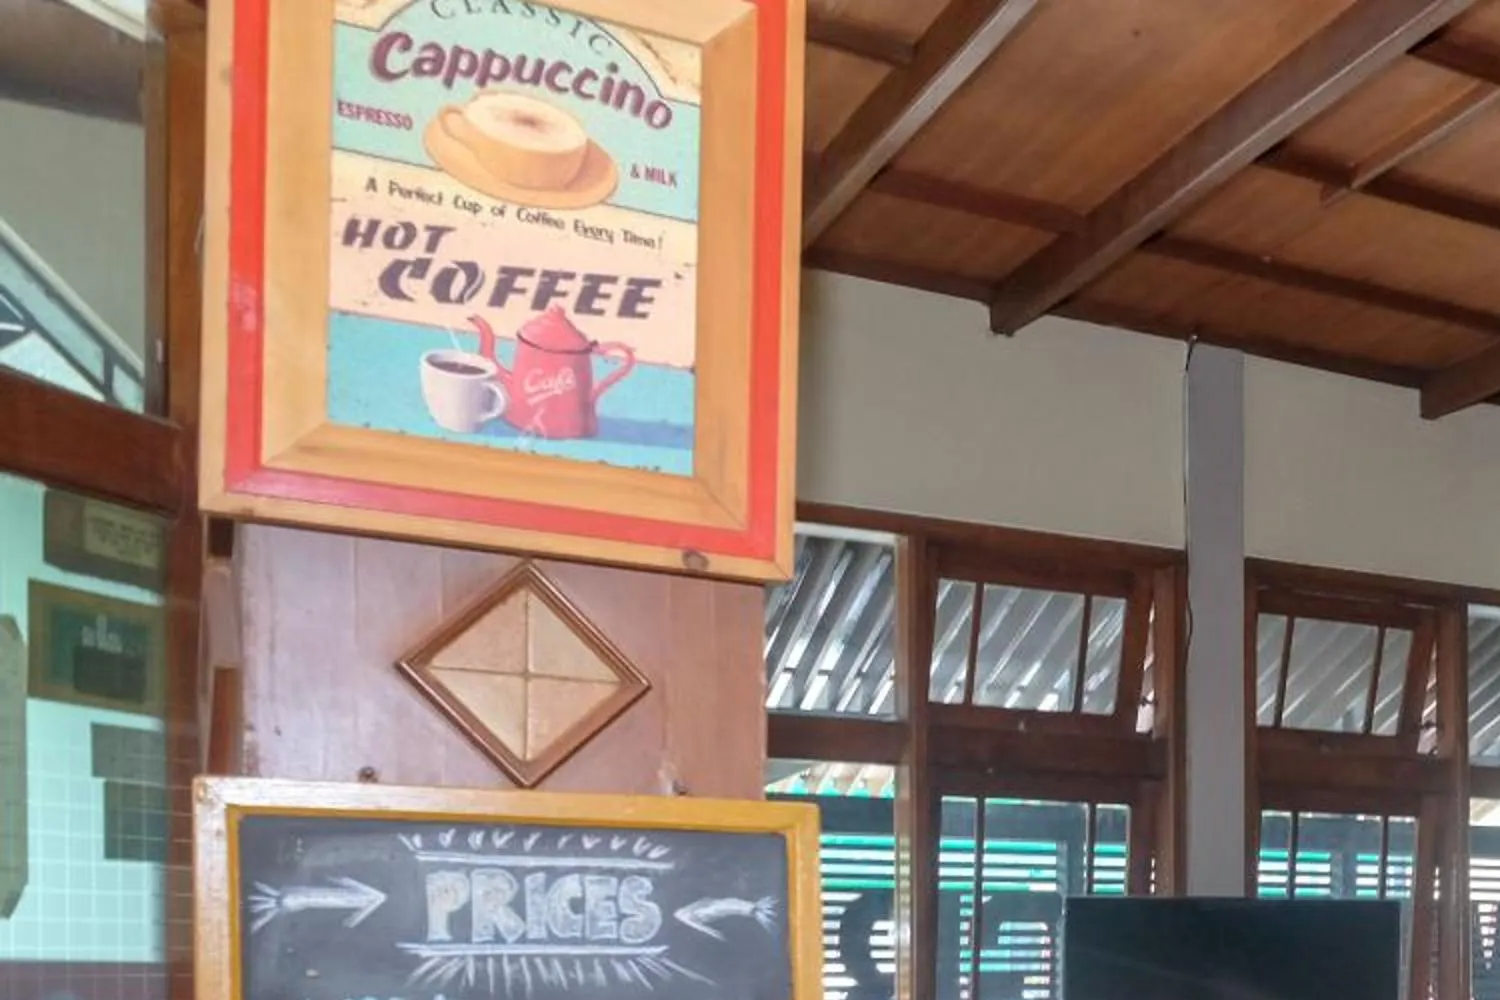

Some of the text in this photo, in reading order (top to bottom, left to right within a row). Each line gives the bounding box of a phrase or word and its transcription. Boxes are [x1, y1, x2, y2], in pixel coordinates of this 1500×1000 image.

[369, 31, 674, 130] Cappuccino
[336, 99, 414, 131] ESPRESSO
[645, 164, 678, 188] MILK
[341, 217, 457, 253] HOT
[365, 176, 664, 250] A Perfect Cup of Coffee Every Time!
[378, 257, 663, 320] COFFEE
[425, 868, 664, 944] PRICES
